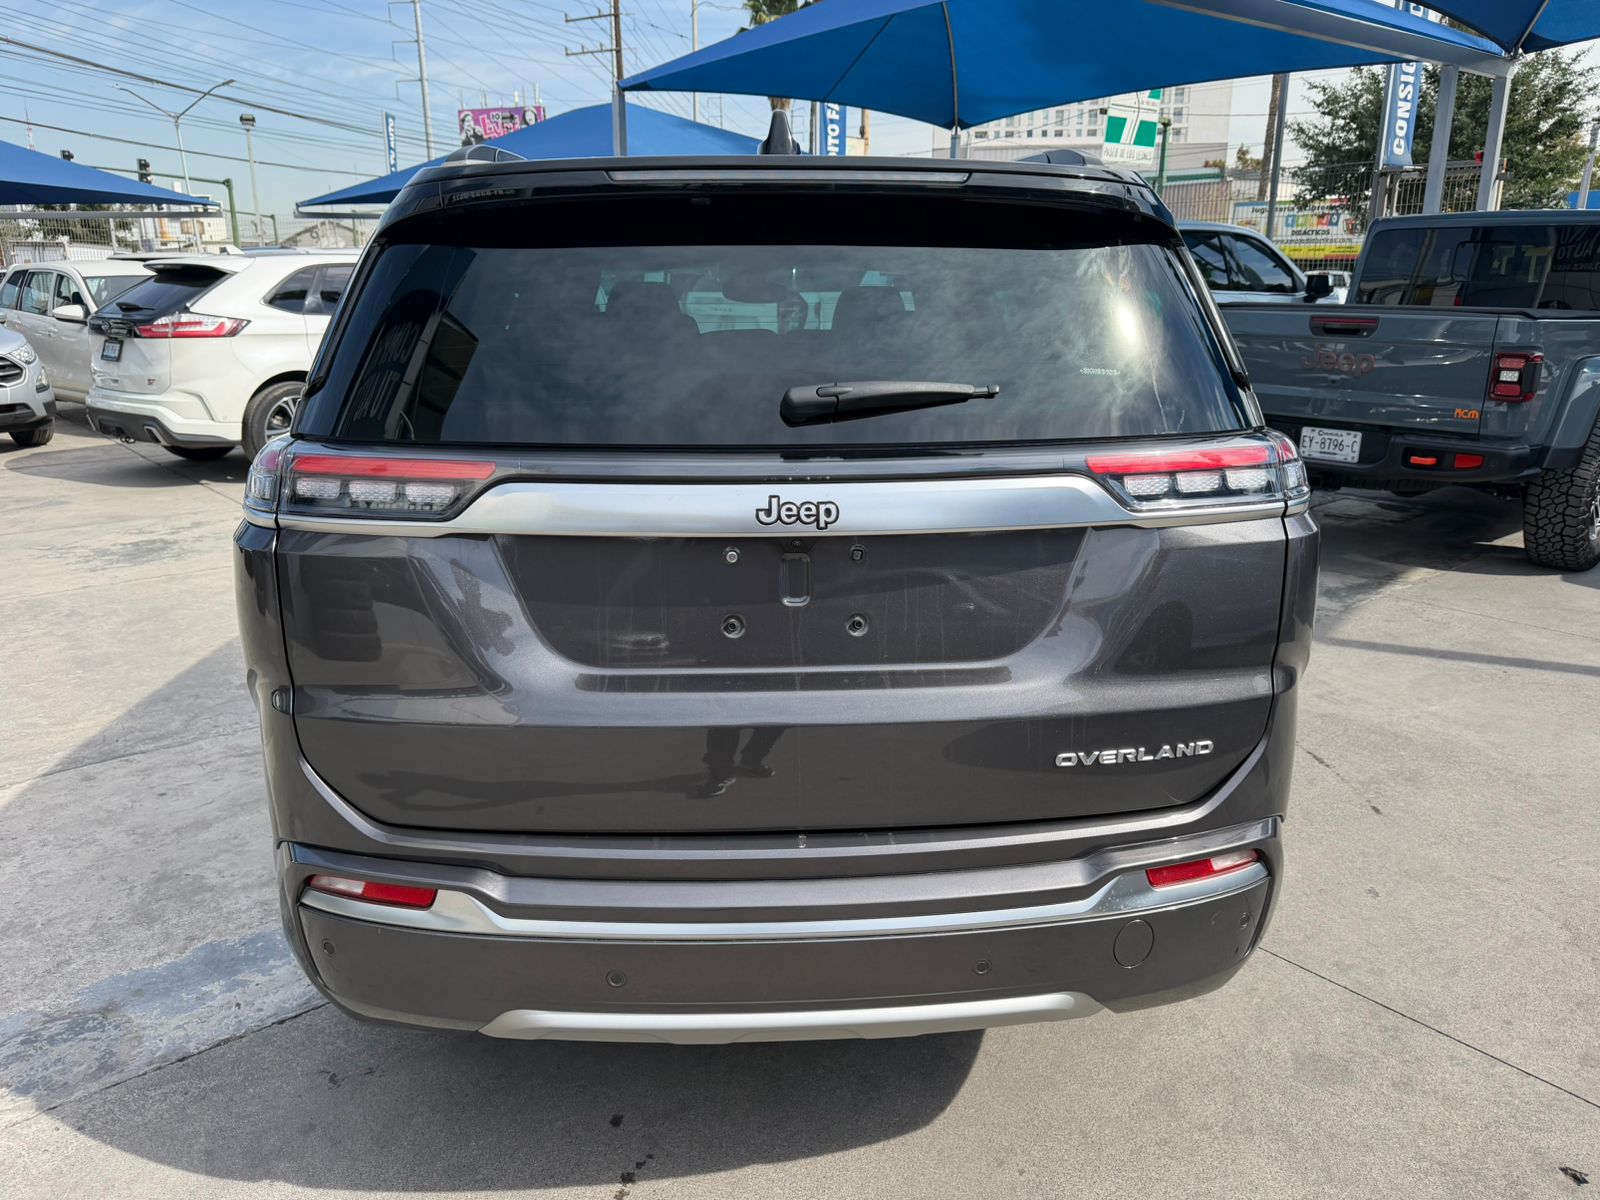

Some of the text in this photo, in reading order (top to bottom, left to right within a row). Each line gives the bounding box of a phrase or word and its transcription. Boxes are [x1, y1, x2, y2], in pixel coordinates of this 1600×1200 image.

[1301, 343, 1377, 377] Jeep
[1301, 434, 1358, 454] EY-8796-C
[755, 495, 840, 530] Jeep
[1055, 740, 1214, 767] OVERLAND
